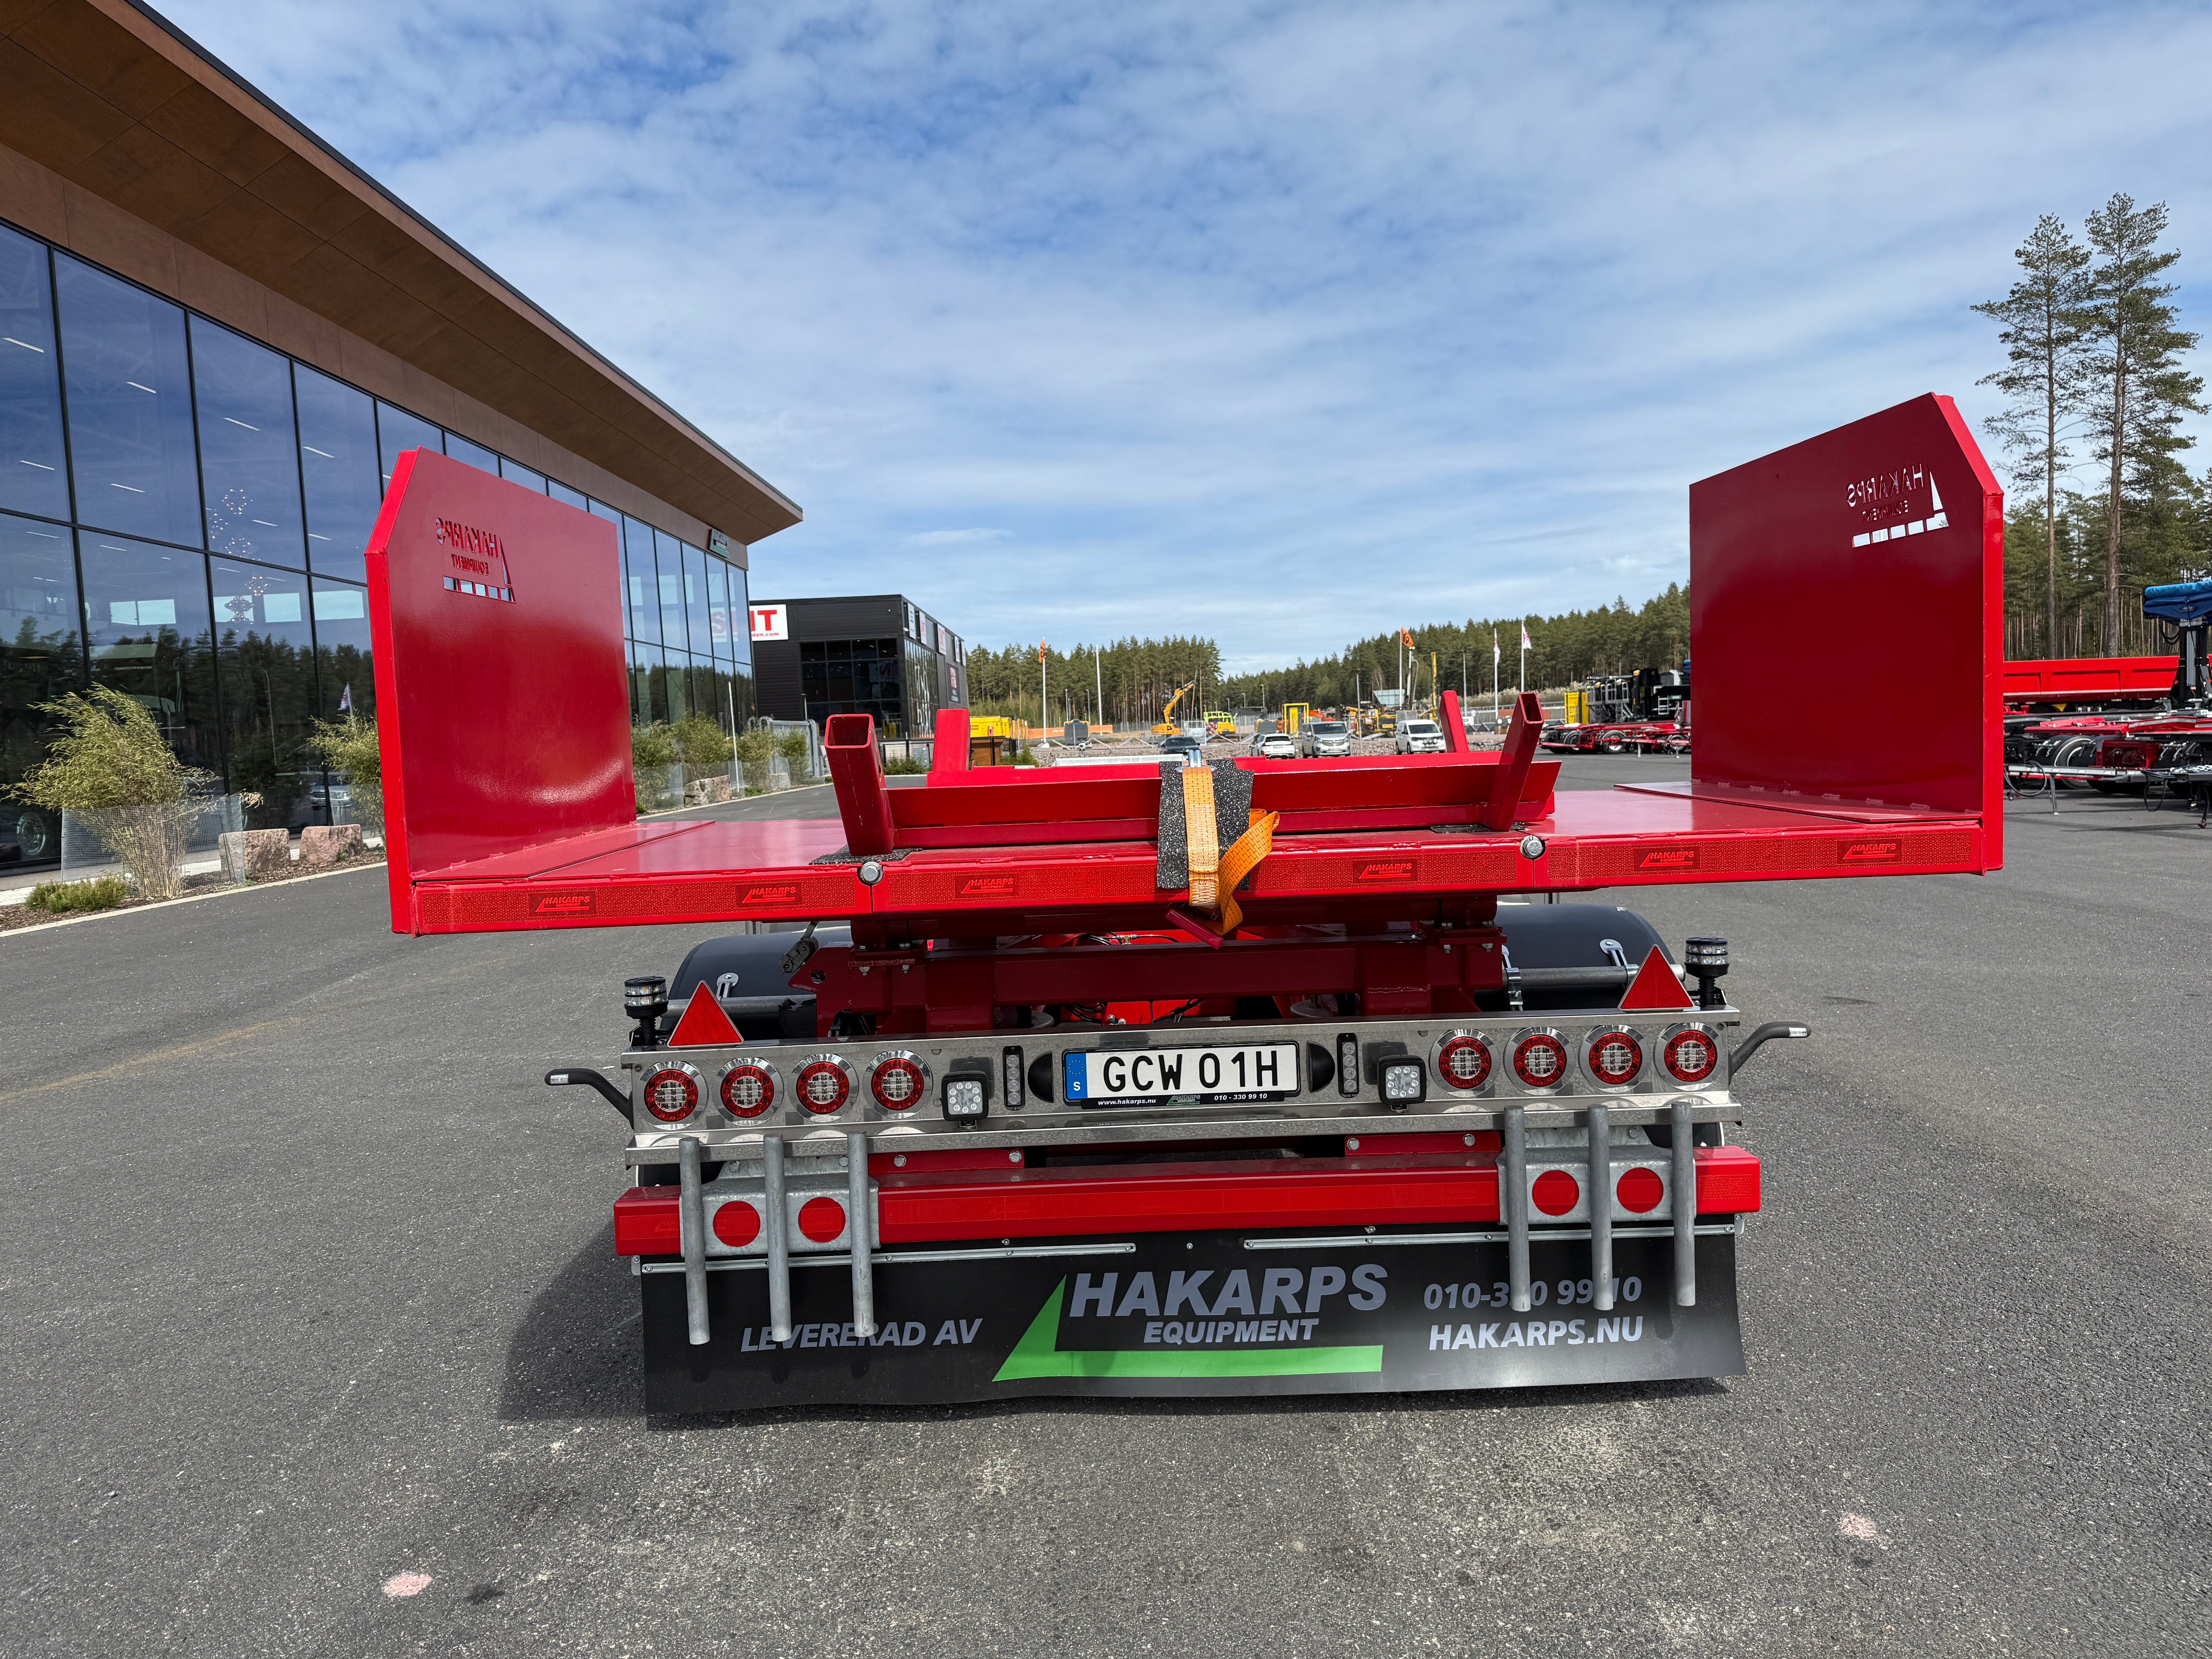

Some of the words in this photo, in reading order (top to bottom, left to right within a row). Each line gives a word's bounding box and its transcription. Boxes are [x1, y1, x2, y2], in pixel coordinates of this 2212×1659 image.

[752, 887, 796, 895] HAKARPS
[971, 878, 1013, 886] HAKARPS
[546, 896, 590, 904] HAKARPS
[1103, 1054, 1183, 1092] GCW
[1199, 1051, 1278, 1088] 01H
[1073, 1081, 1080, 1091] S
[1069, 1264, 1388, 1317] HAKARPS
[1424, 1281, 1548, 1309] 010-30
[1557, 1279, 1593, 1305] 99
[933, 1318, 983, 1346] AV
[1144, 1318, 1319, 1345] EQUIPMENT
[1429, 1316, 1643, 1350] HAKARPS.NU
